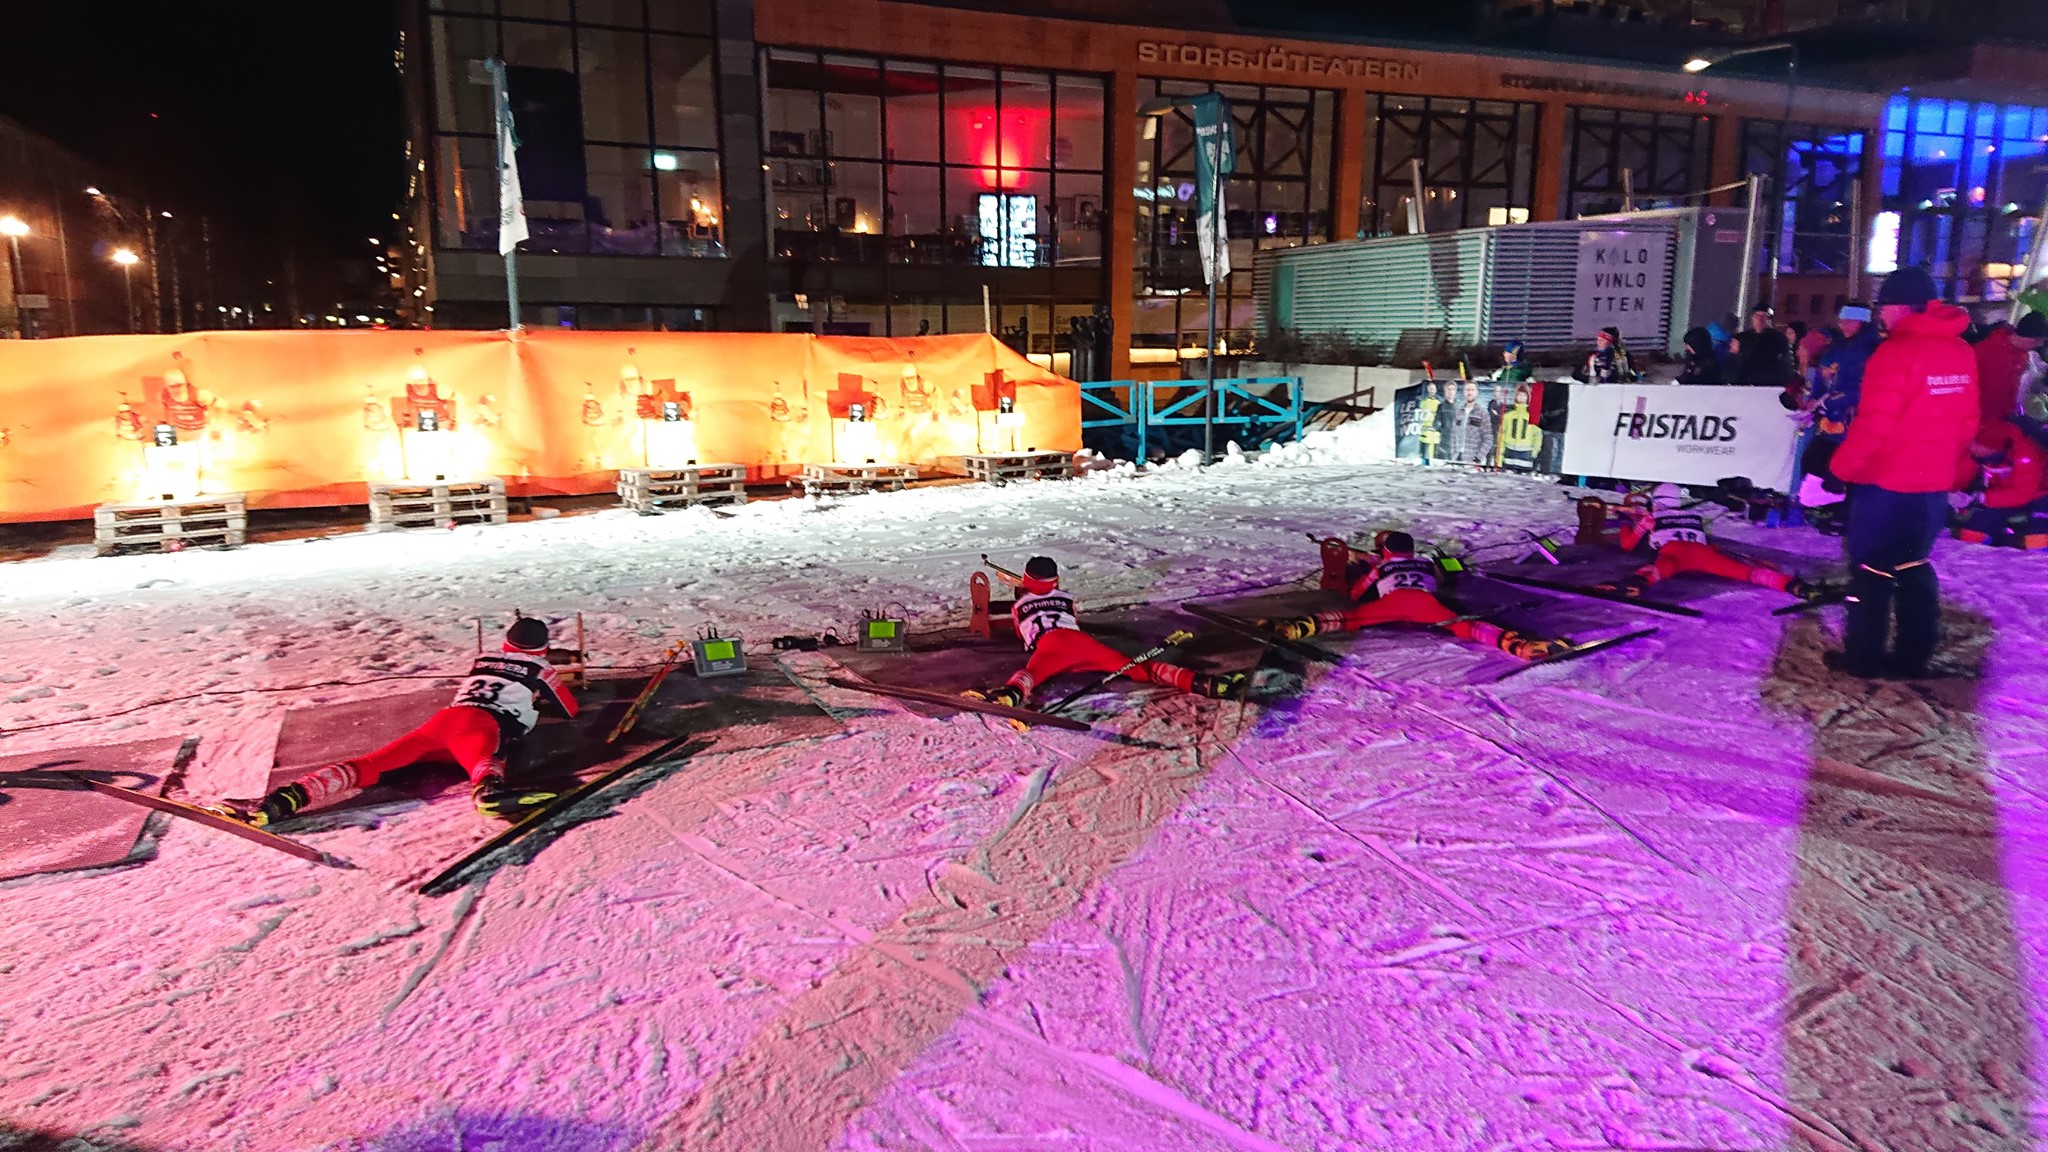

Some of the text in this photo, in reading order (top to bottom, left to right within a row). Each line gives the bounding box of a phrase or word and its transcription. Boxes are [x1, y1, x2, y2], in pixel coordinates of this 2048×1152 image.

[1137, 43, 1422, 81] STORSJÖTEATERN
[1594, 272, 1646, 289] VINLO
[1592, 296, 1645, 313] TTEN
[1613, 412, 1738, 442] FRISTADS
[157, 432, 172, 446] 5
[1676, 444, 1736, 456] WORKWEAR
[1394, 573, 1425, 589] 22
[457, 679, 505, 704] 23
